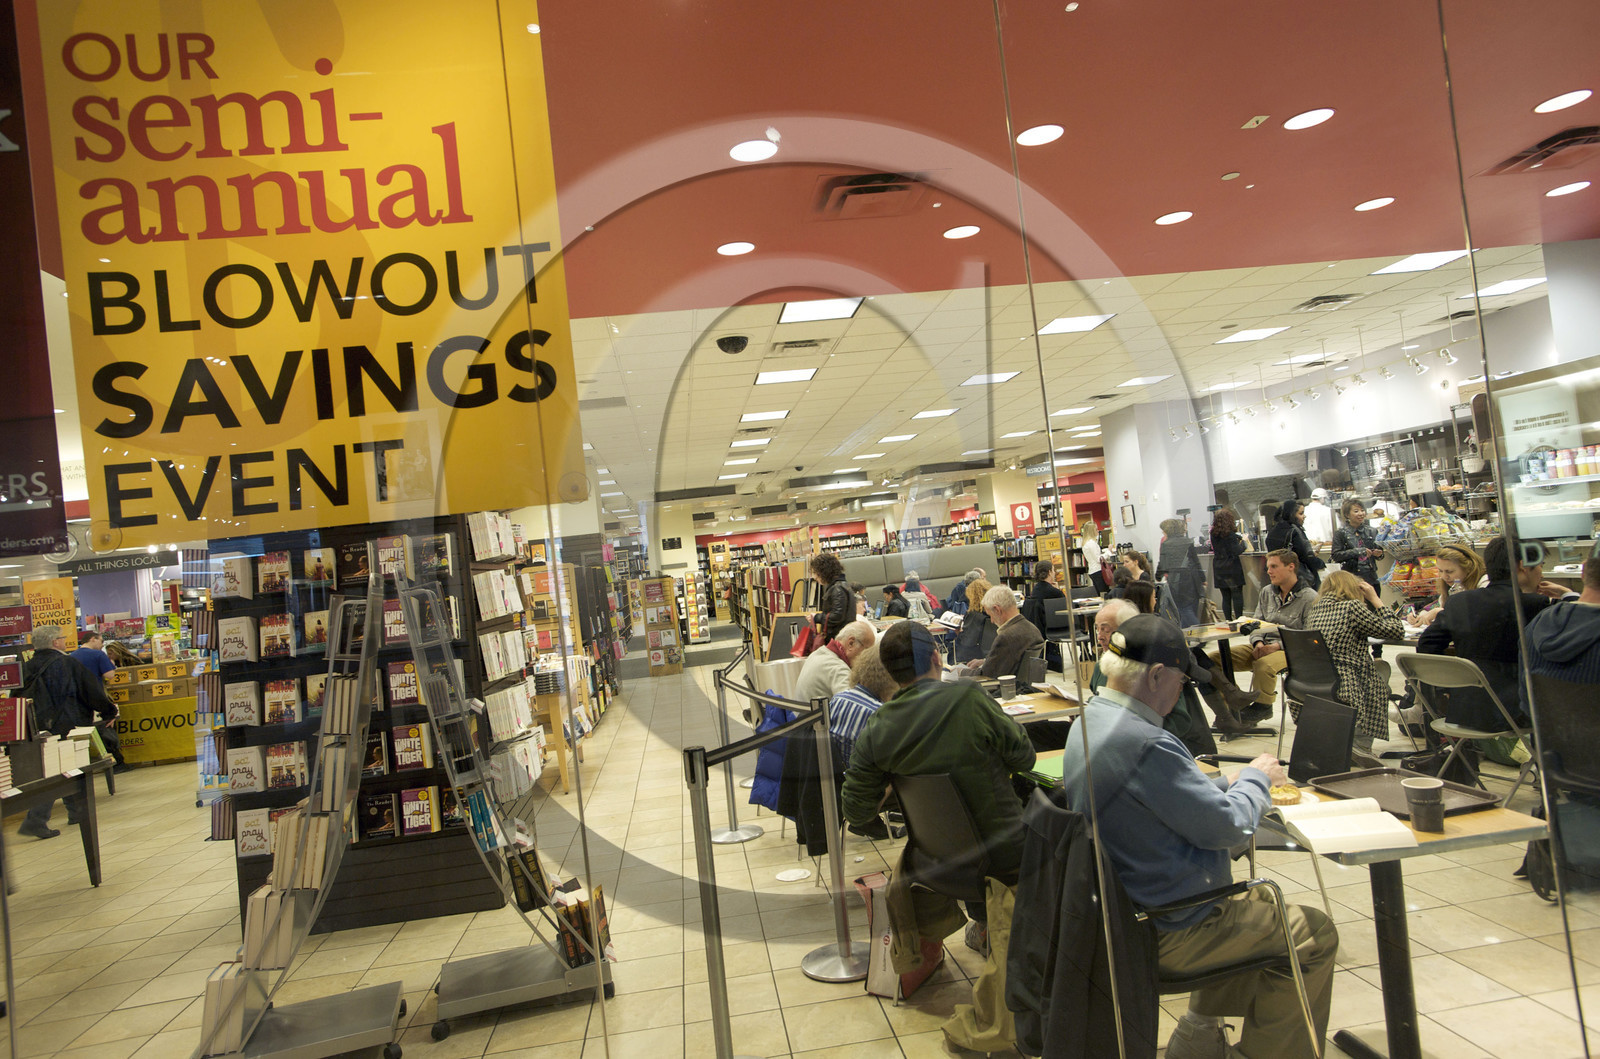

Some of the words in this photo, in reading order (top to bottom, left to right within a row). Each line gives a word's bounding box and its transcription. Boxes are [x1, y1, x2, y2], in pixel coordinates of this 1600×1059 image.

[62, 33, 219, 82] OUR
[72, 58, 383, 163] semi-
[78, 122, 473, 246] annual
[87, 242, 551, 336] BLOWOUT
[91, 330, 557, 439] SAVINGS
[104, 439, 404, 530] EVENT
[378, 547, 404, 562] WHITE
[77, 564, 92, 572] ALL
[95, 559, 129, 570] THINGS
[131, 556, 161, 566] LOCAL
[379, 560, 405, 574] TIGER
[389, 672, 416, 688] WHITE
[391, 686, 418, 700] TIGER
[117, 710, 206, 734] BLOWOUT
[394, 737, 421, 752] WHITE
[396, 750, 422, 765] TIGER
[403, 800, 429, 815] WHITE
[404, 813, 431, 828] TIGER
